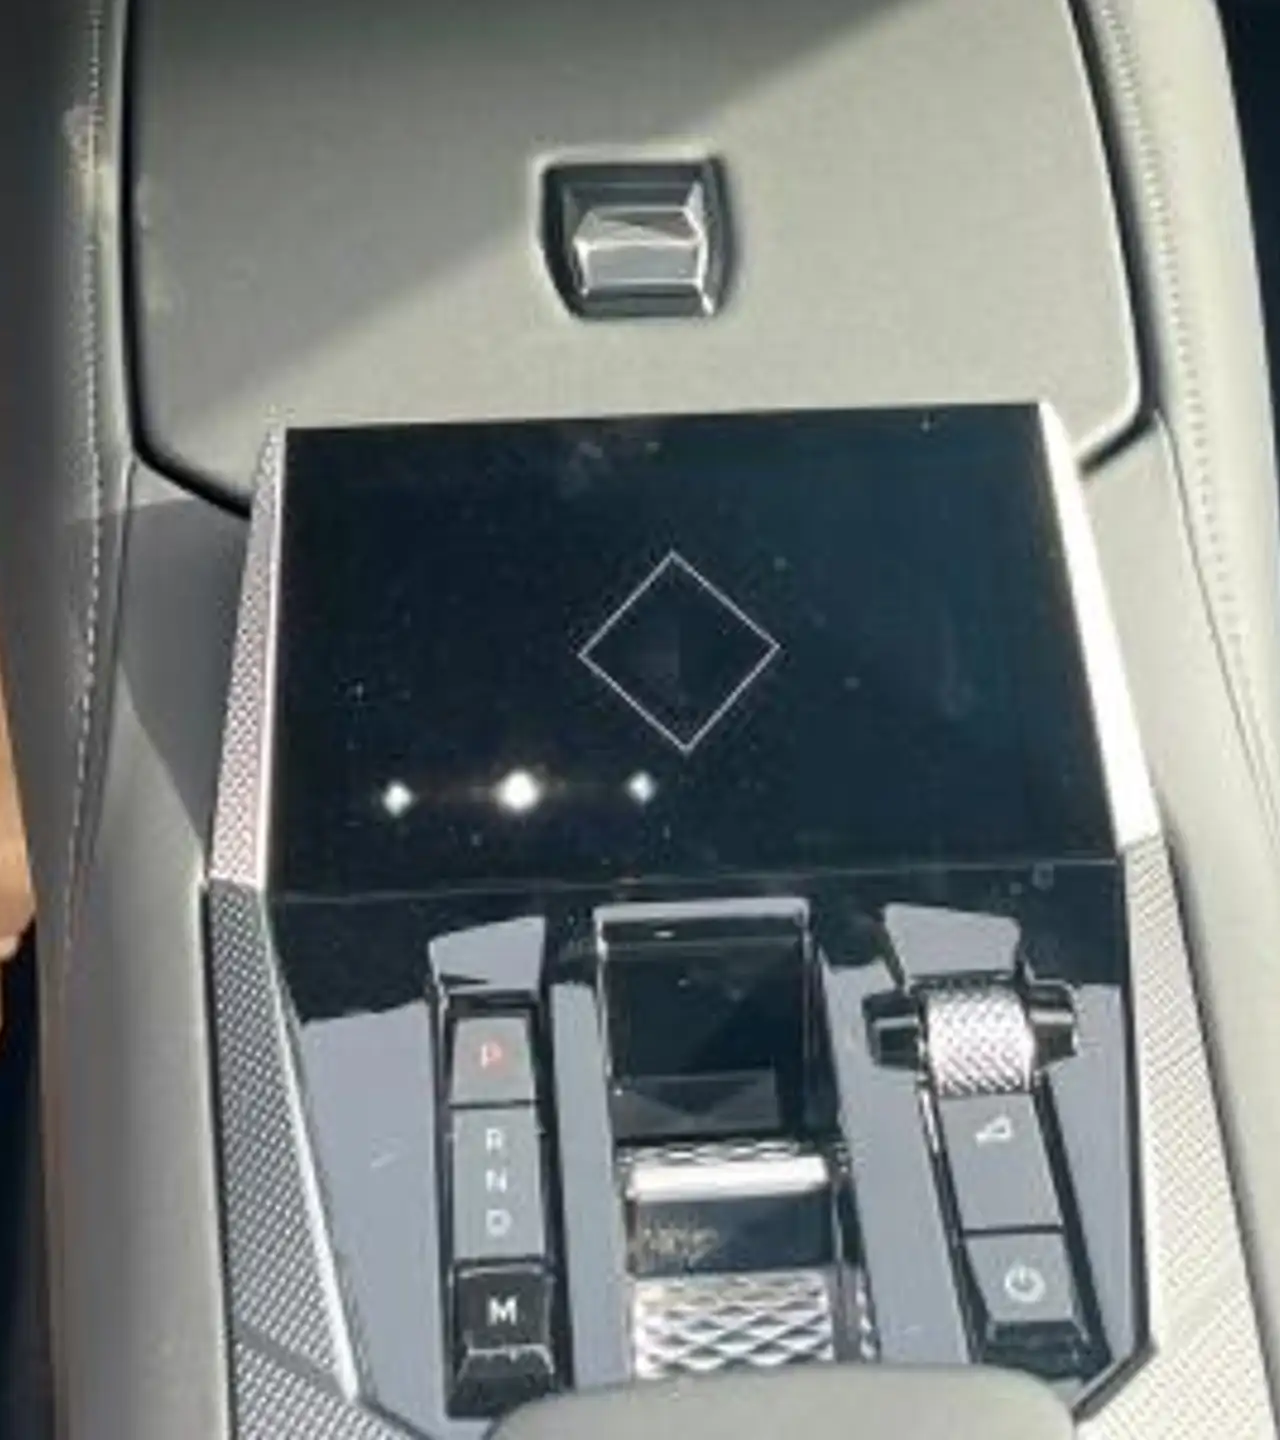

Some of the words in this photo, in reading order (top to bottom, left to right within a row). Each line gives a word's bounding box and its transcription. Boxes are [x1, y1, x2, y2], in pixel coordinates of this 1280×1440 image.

[480, 1042, 503, 1069] P
[485, 1127, 504, 1152] R
[485, 1168, 508, 1194] N
[485, 1208, 513, 1238] D
[487, 1296, 518, 1327] M
